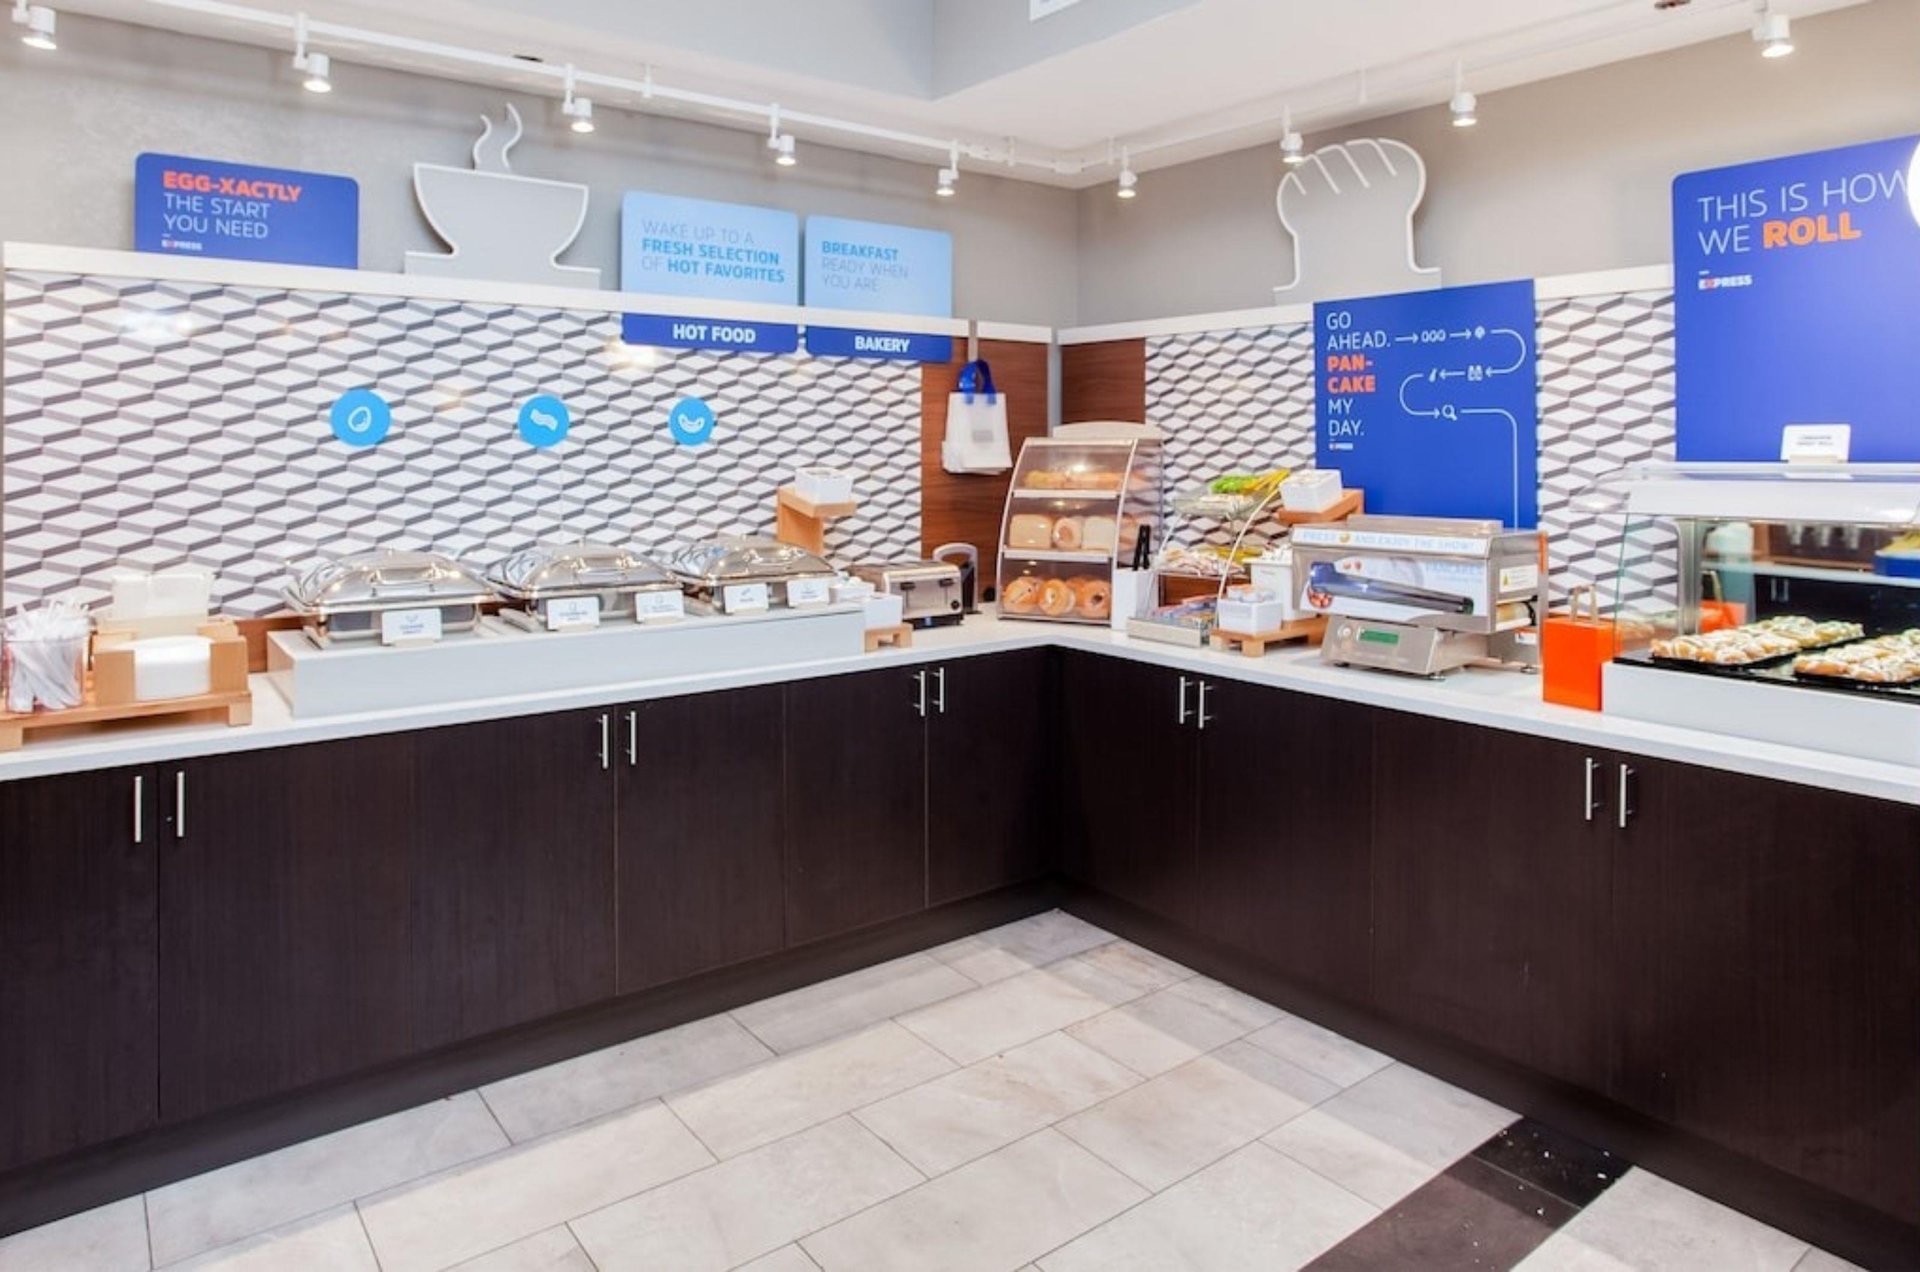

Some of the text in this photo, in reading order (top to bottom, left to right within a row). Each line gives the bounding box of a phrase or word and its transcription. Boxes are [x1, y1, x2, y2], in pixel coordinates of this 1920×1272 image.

[163, 170, 302, 202] EGG-XACTLY
[1697, 169, 1908, 222] THIS IS HOW
[163, 192, 270, 219] THE START
[163, 213, 269, 239] YOU NEED
[641, 219, 754, 244] WAKE UP TO A
[1698, 211, 1862, 256] WE ROLL
[641, 238, 780, 265] FRESH SELECTION
[821, 240, 899, 261] BREAKFAST
[641, 255, 785, 283] OF HOT FAVORITES
[821, 256, 909, 279] READY WHEN
[821, 272, 879, 291] YOU ARE
[1698, 274, 1752, 290] EXPRESS
[1326, 311, 1351, 330] GO
[673, 323, 756, 344] HOT FOOD
[854, 335, 910, 353] BAKERY
[1327, 330, 1391, 351] AHEAD.
[1327, 353, 1373, 372] PAN-
[1327, 375, 1376, 393] CAKE
[1327, 398, 1353, 415] MY
[1328, 419, 1365, 436] DAY.
